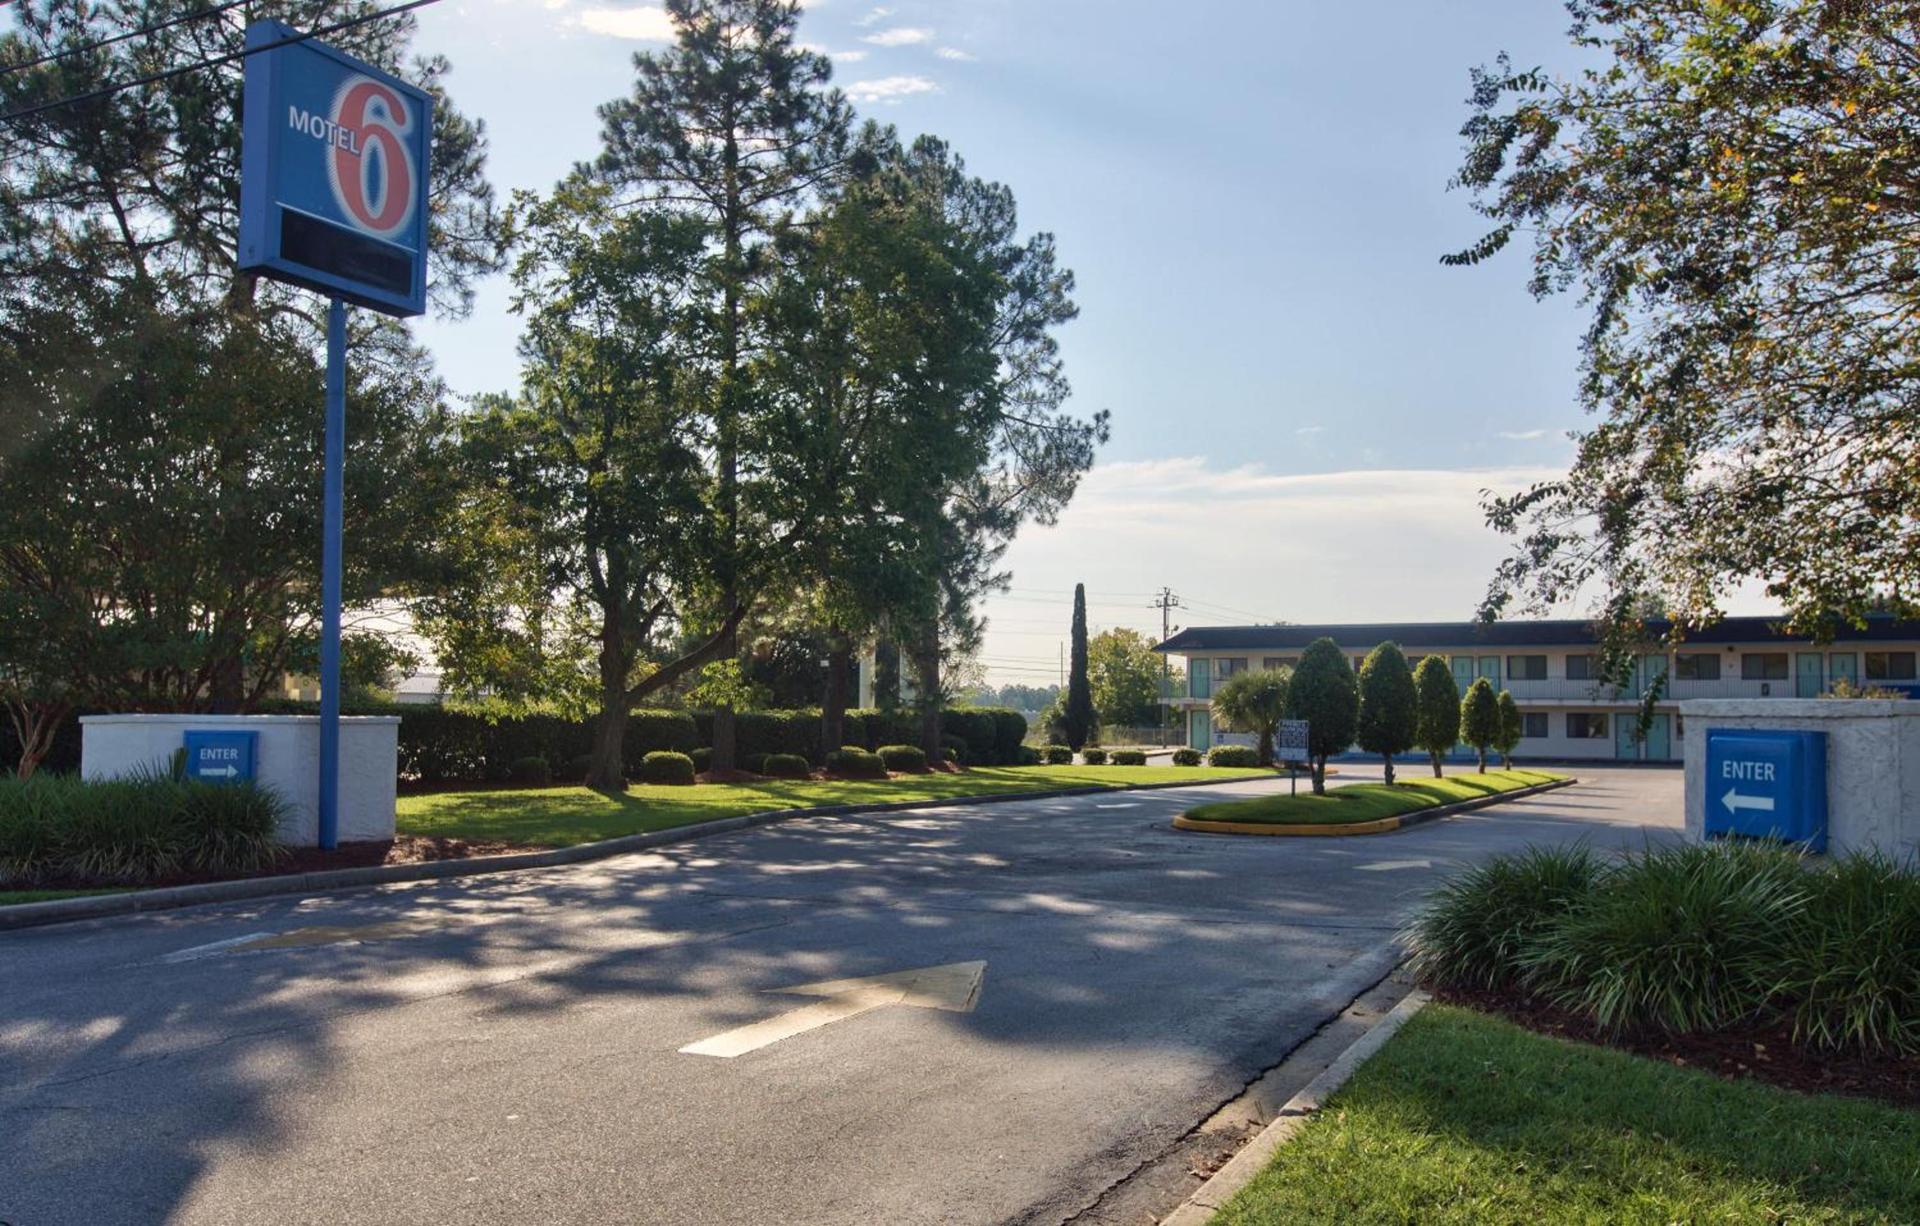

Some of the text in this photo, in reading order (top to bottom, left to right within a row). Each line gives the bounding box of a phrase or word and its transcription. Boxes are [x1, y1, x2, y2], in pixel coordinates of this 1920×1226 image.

[289, 80, 411, 232] MOTEL 6
[200, 748, 238, 760] ENTER
[1723, 760, 1775, 781] ENTER
